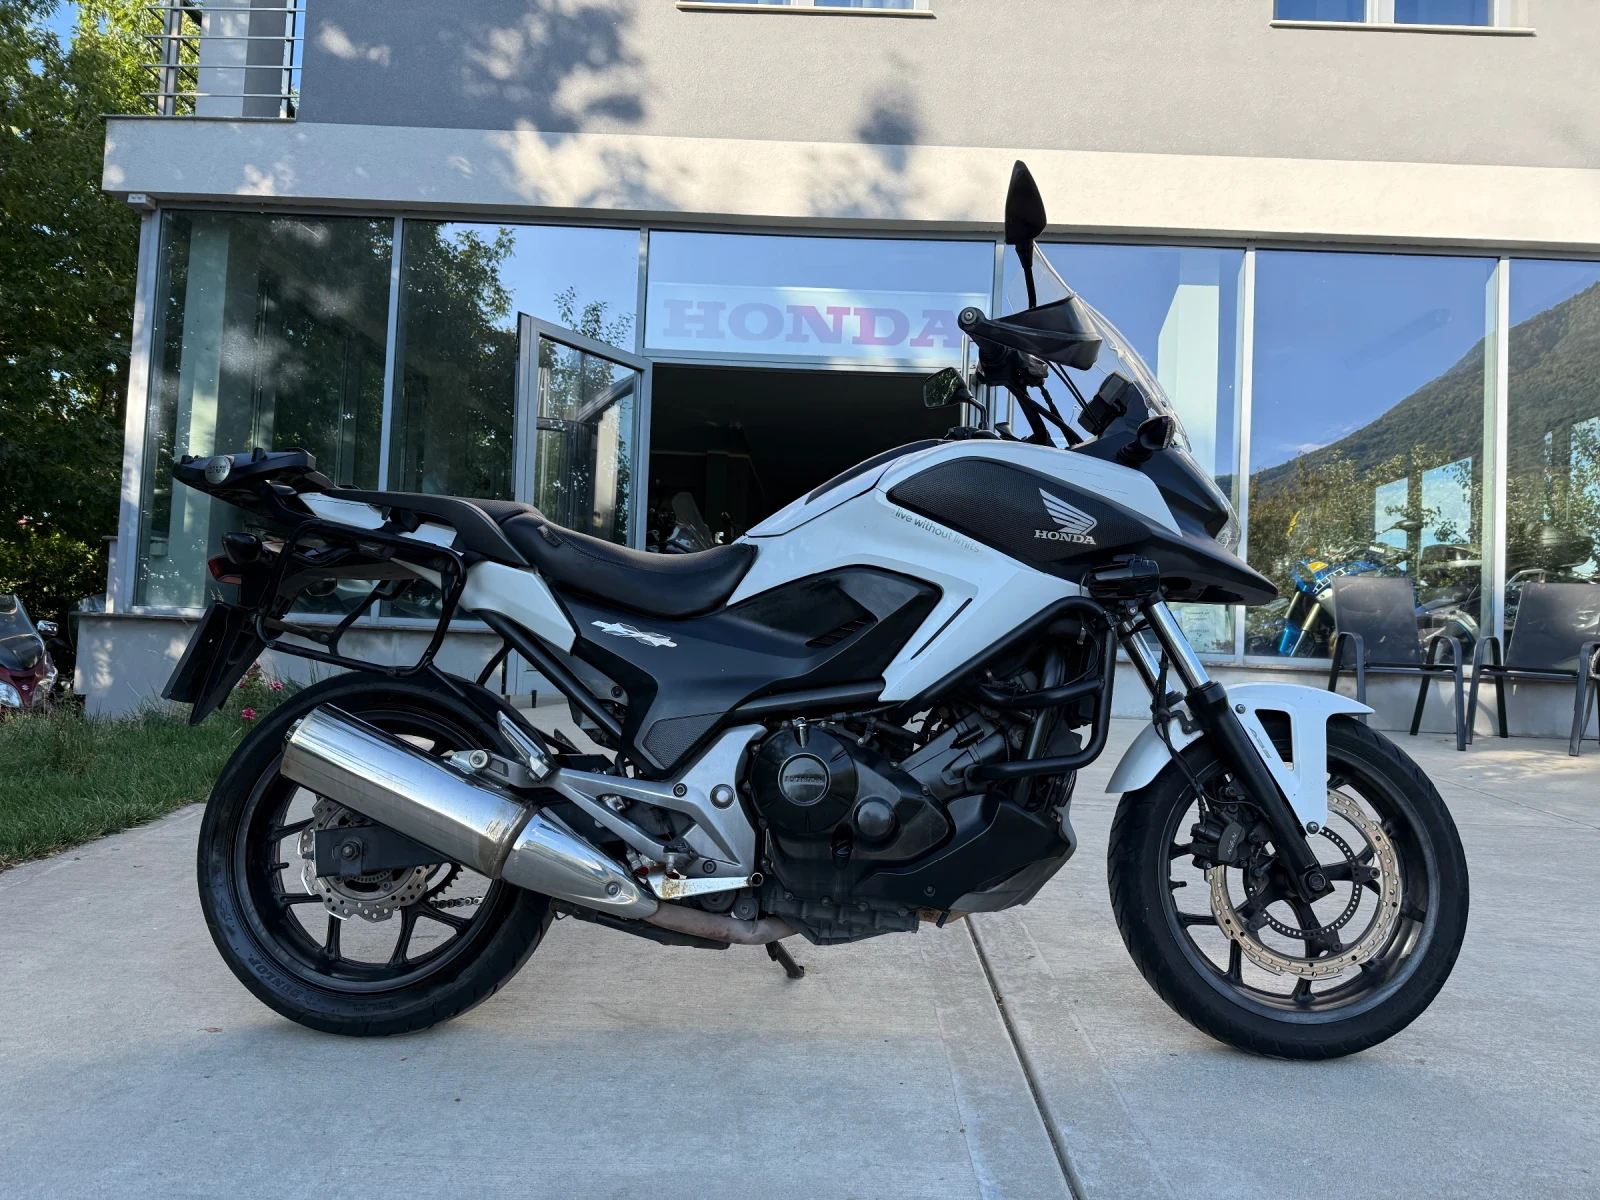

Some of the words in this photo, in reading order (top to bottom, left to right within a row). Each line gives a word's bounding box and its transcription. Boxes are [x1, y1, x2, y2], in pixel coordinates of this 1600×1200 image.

[662, 299, 973, 349] HONDA
[894, 508, 913, 523] live
[914, 518, 954, 541] without
[952, 533, 980, 553] limits
[1034, 529, 1097, 545] HONDA
[248, 957, 304, 1000] DUNLOP
